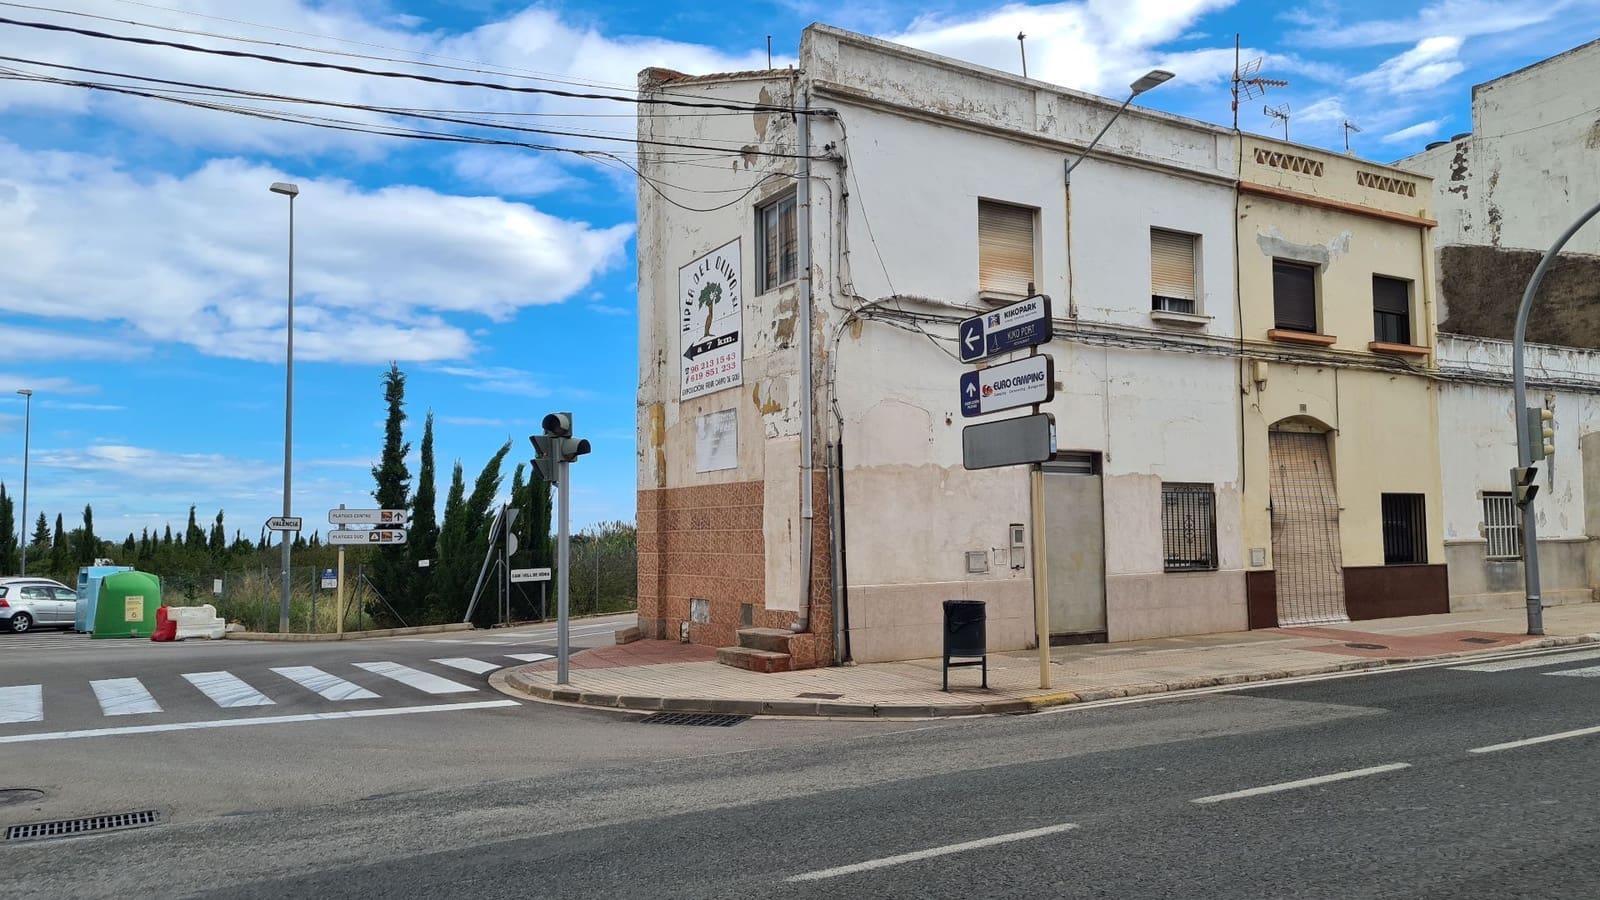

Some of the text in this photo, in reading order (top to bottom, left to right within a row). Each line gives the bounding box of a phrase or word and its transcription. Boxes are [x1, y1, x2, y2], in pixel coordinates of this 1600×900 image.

[683, 288, 696, 332] HIPER
[693, 258, 710, 285] DEL
[1003, 302, 1037, 319] KIKOPARK
[1007, 324, 1035, 341] KIKO PORT
[706, 341, 713, 350] 7
[716, 336, 735, 346] km.
[690, 364, 699, 374] 96
[690, 372, 703, 382] 619
[705, 367, 719, 377] 851
[993, 371, 1045, 391] EURO CAMPING
